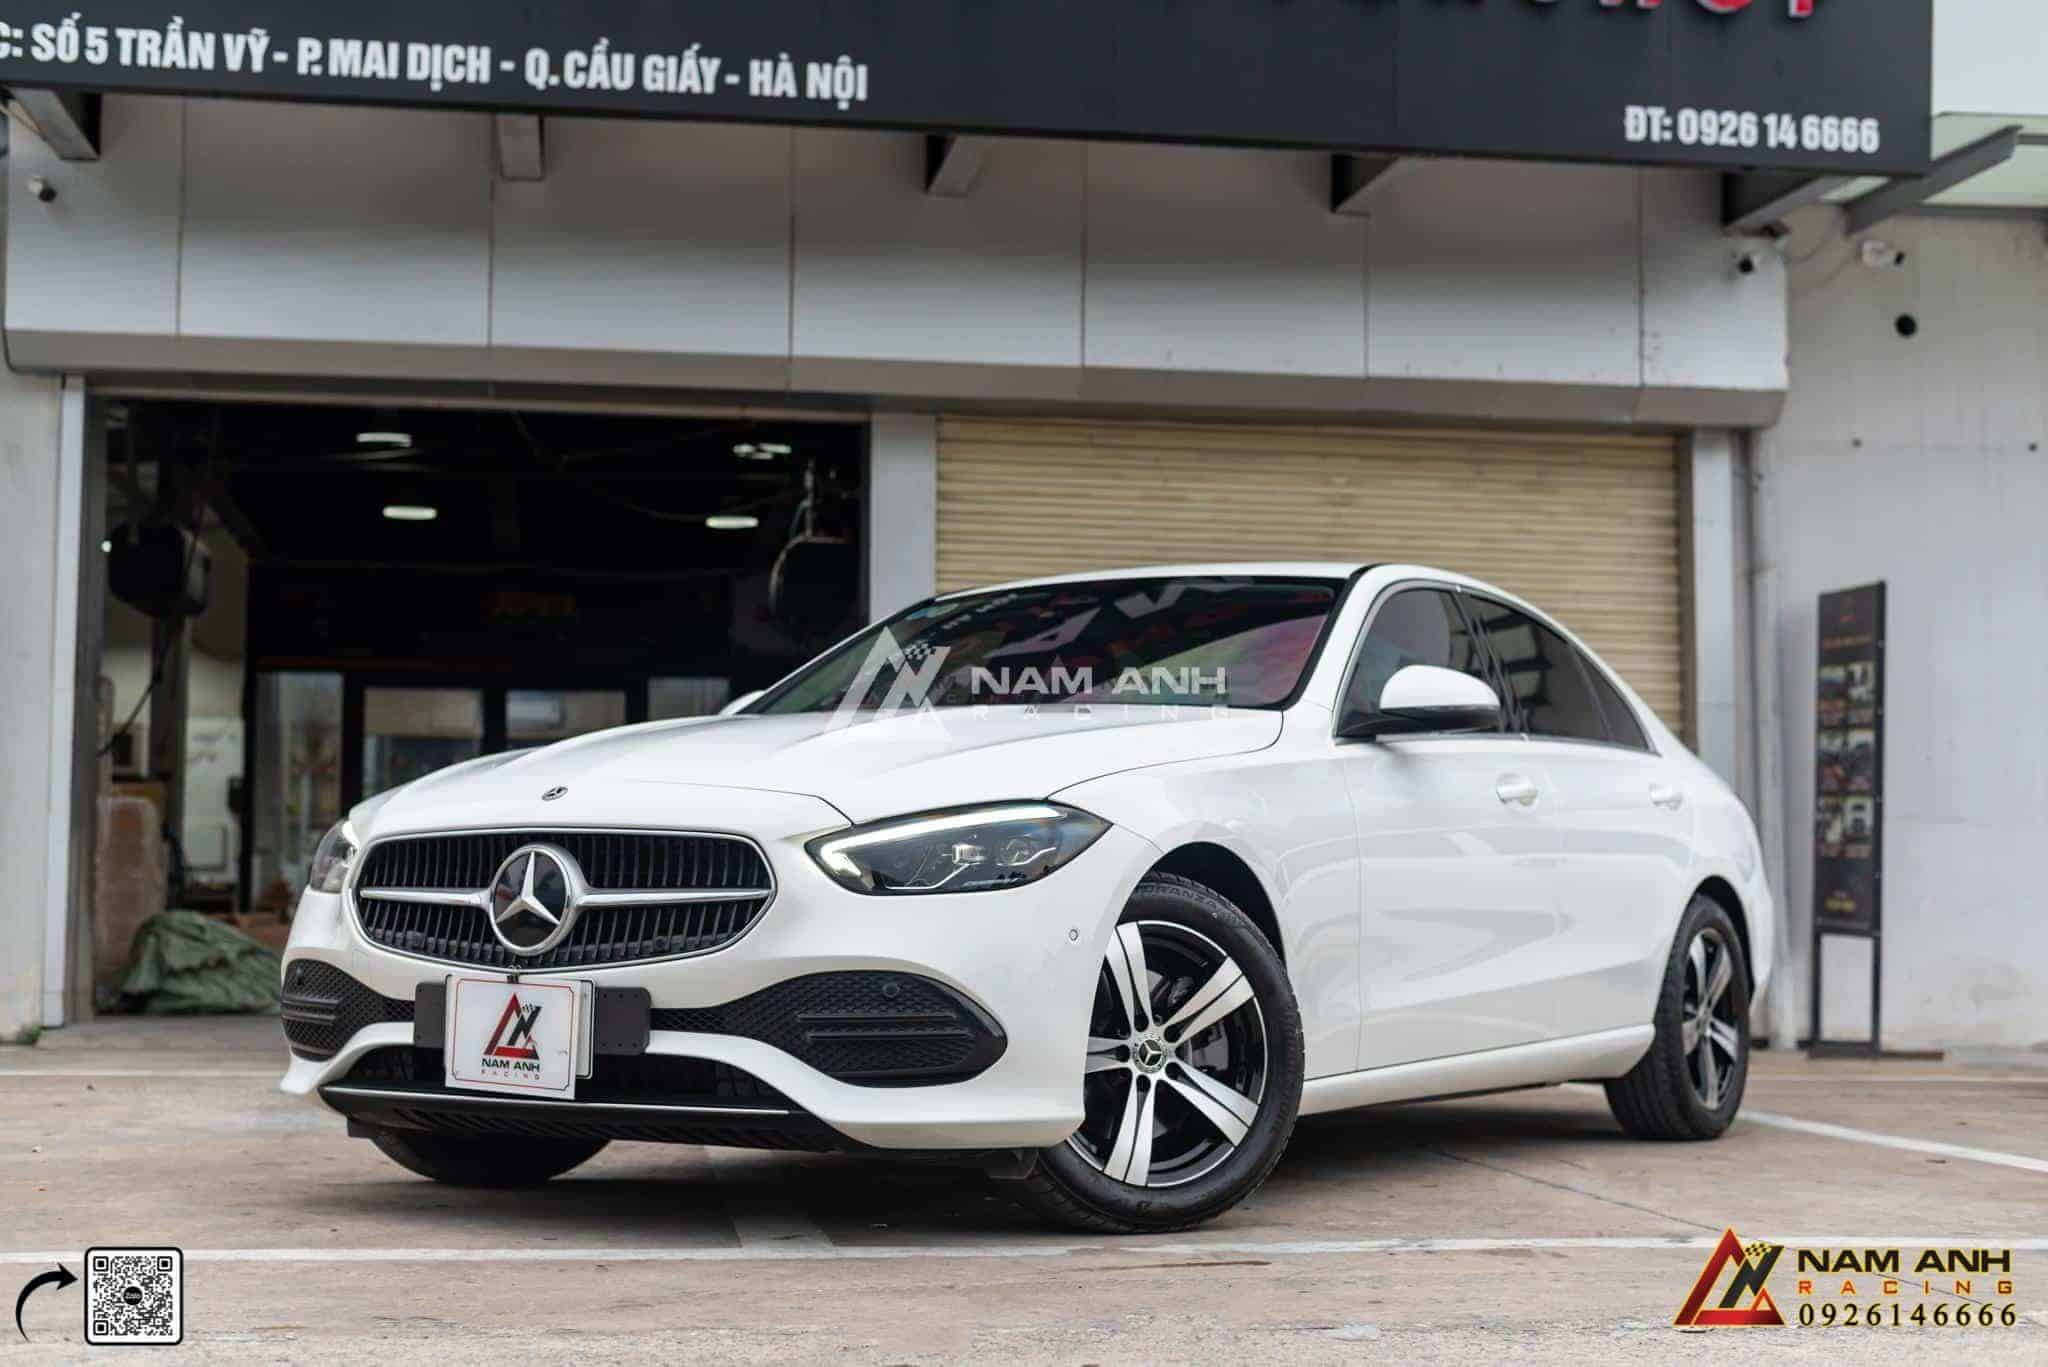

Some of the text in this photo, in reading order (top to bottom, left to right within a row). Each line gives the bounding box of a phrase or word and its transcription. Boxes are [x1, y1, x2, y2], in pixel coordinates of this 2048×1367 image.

[31, 11, 82, 63] SỐ
[85, 26, 108, 64] 5
[115, 15, 216, 71] TRẦN
[222, 27, 271, 73] VỸ
[406, 42, 491, 92] DỊCH
[642, 43, 721, 94] GIẤY
[749, 52, 797, 98] HÀ
[806, 54, 868, 110] NỘI
[482, 1058, 540, 1073] NAM ANH
